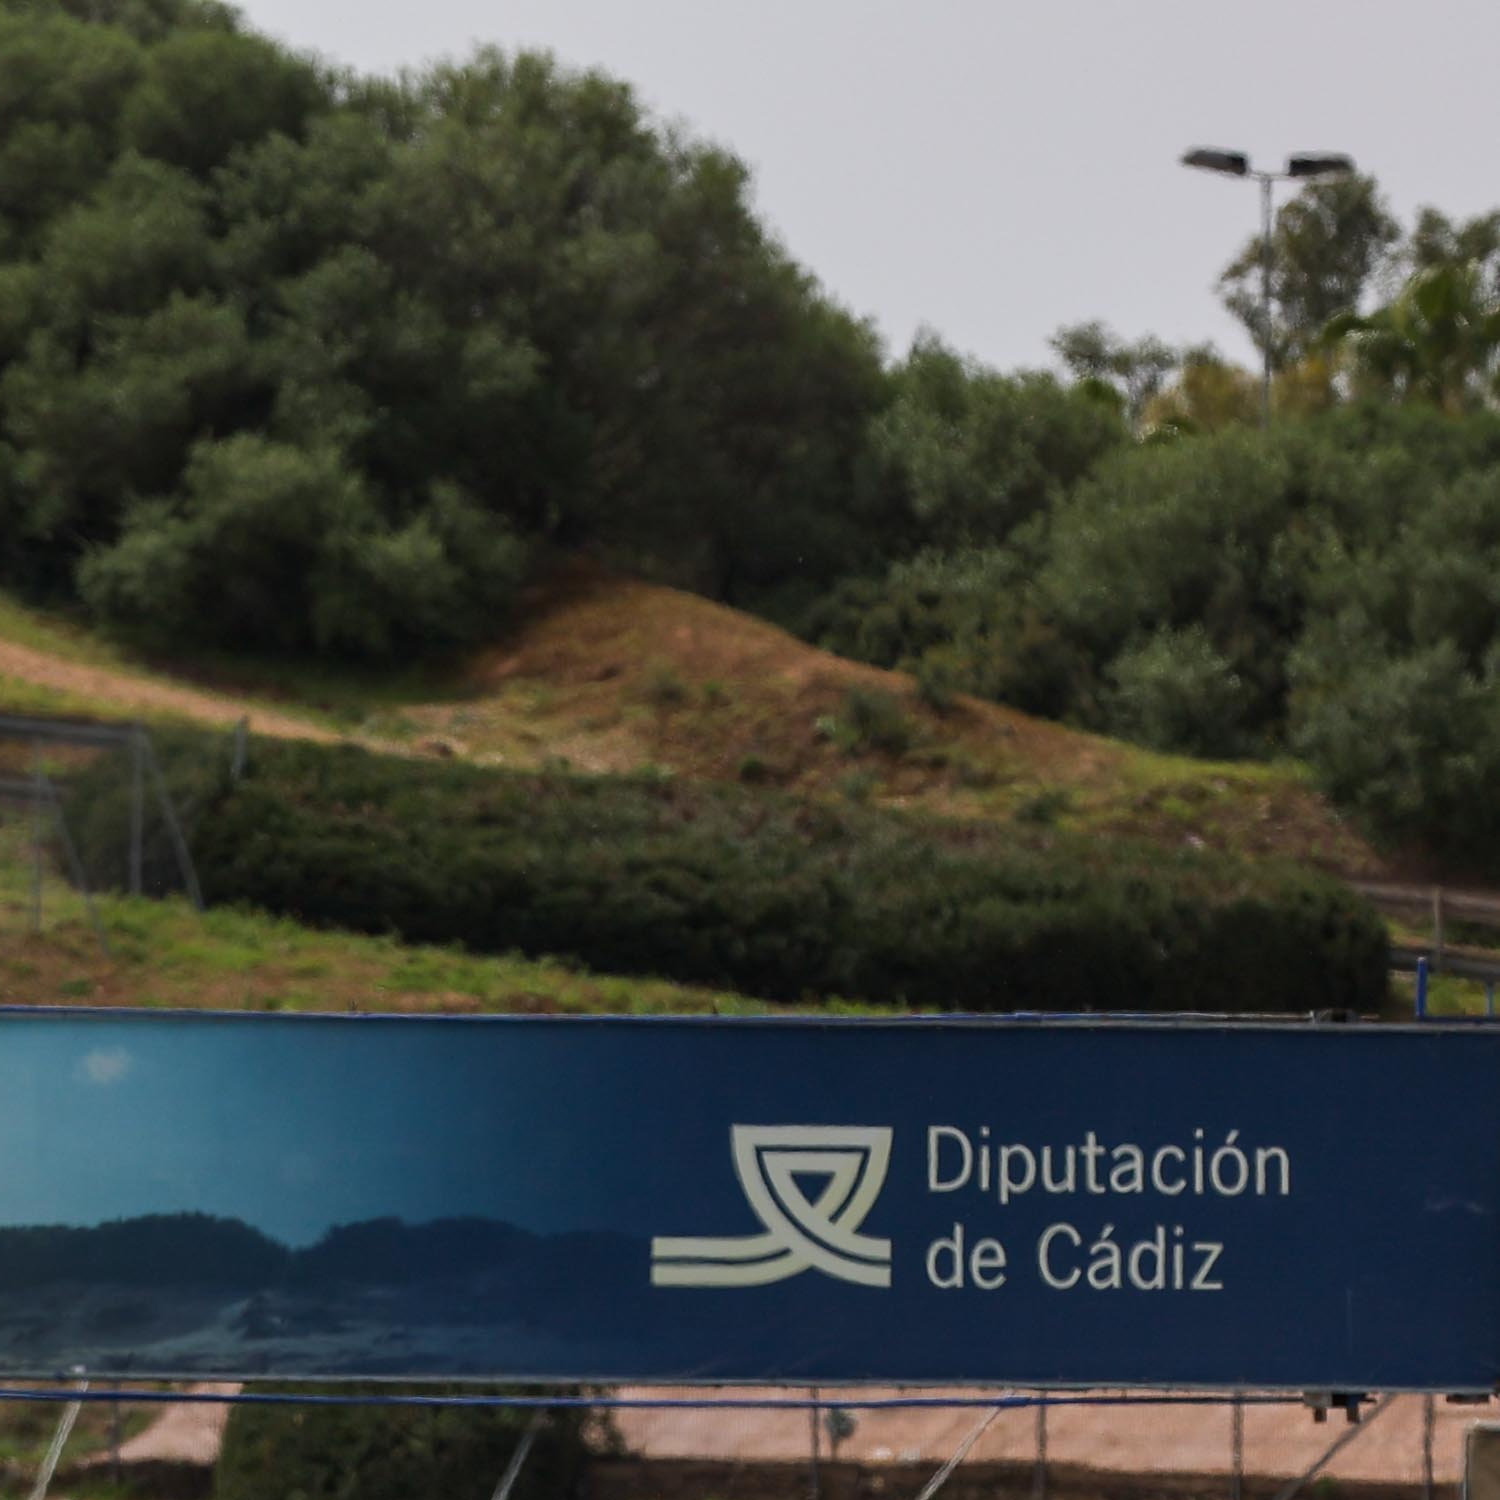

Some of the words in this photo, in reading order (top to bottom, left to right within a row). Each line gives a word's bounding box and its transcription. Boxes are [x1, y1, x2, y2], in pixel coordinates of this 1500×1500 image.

[927, 1124, 1291, 1205] Diputación
[925, 1224, 1007, 1289] de
[1037, 1221, 1225, 1290] Cádiz
